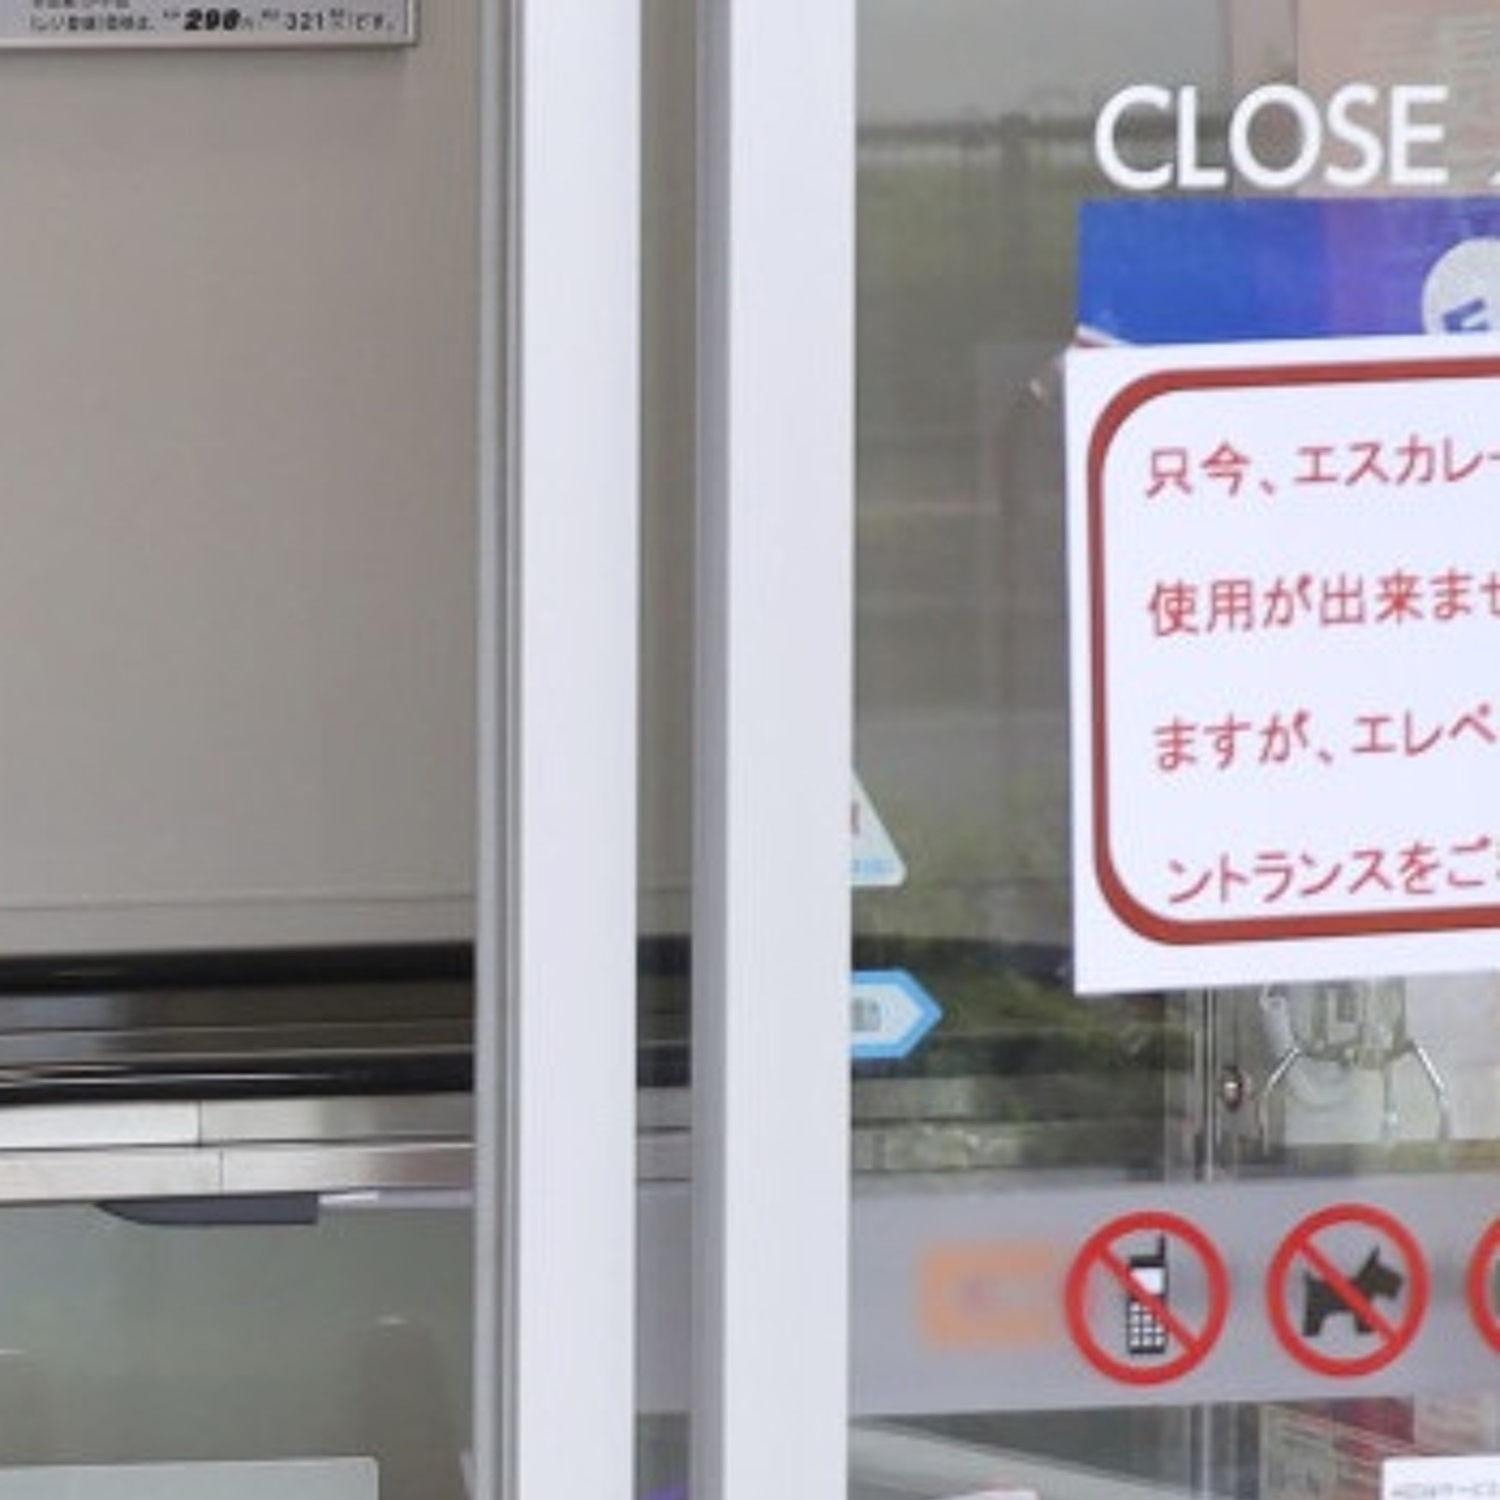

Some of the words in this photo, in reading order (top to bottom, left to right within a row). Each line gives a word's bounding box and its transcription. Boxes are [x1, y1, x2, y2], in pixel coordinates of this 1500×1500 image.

[1095, 83, 1450, 189] CLOSE
[1146, 433, 1500, 498] 只今、エスカレ
[1152, 701, 1497, 771] ますが、エレベ
[1167, 835, 1500, 903] ントランスをご
